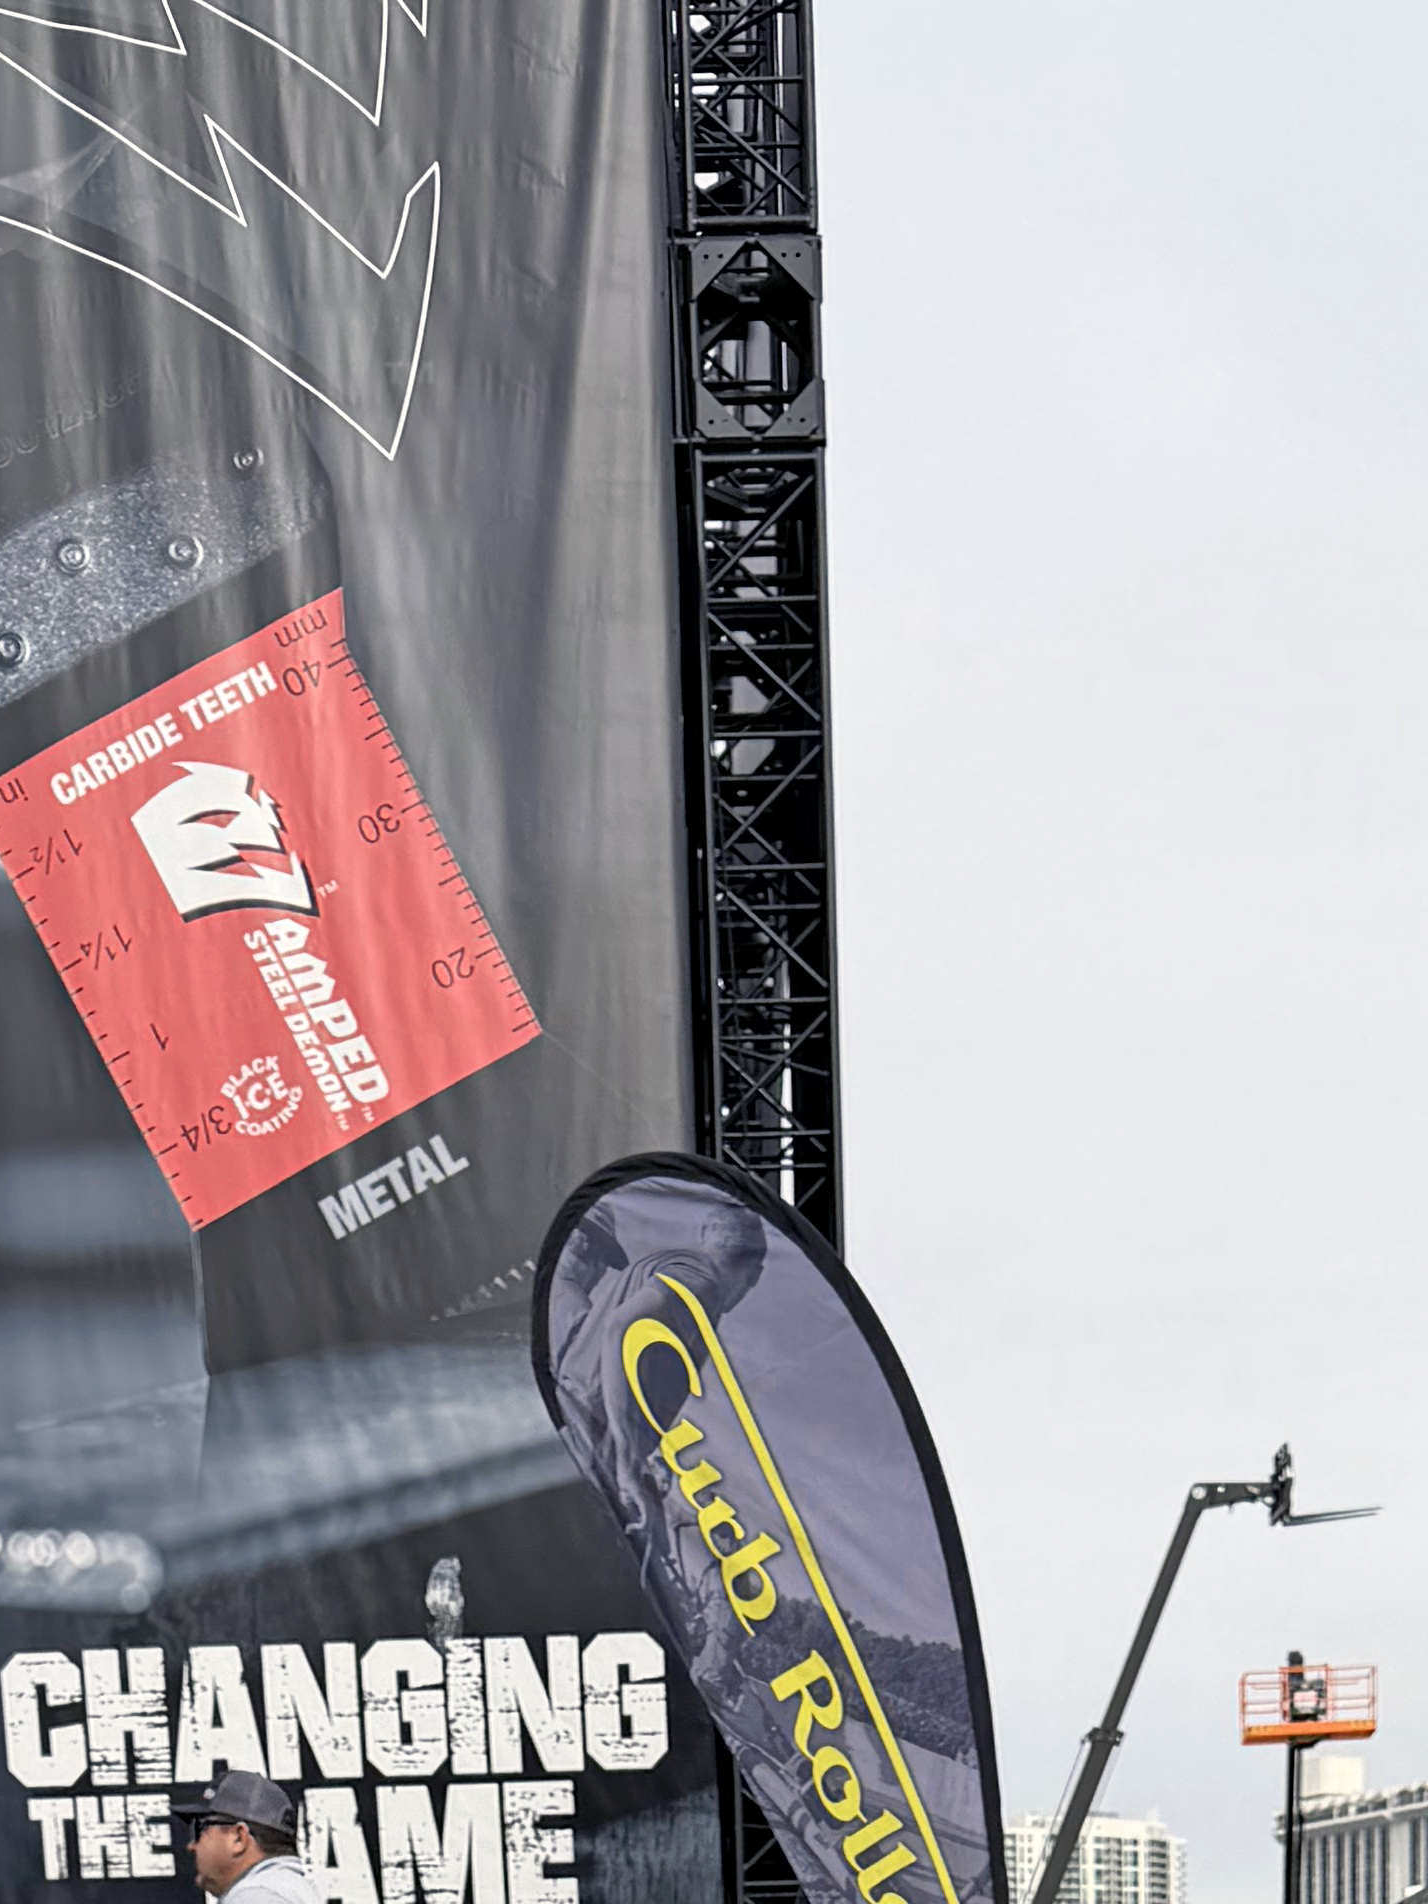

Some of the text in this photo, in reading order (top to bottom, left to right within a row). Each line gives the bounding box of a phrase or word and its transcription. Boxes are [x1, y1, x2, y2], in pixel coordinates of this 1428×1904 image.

[282, 661, 322, 696] 40
[51, 661, 278, 805] CARBIDE TEETH
[358, 803, 401, 844] 30
[431, 947, 475, 988] 20
[149, 1023, 169, 1051] 1
[243, 929, 299, 1012] STEEL
[284, 1012, 353, 1112] DEMON
[264, 918, 389, 1104] AMPED
[220, 1056, 280, 1098] BLACK
[235, 1085, 303, 1136] COATING
[181, 1105, 232, 1151] 3/4
[318, 1134, 470, 1240] METAL
[622, 1317, 783, 1637] Curb
[0, 1630, 671, 1788] CHANGING
[28, 1793, 176, 1880] THE
